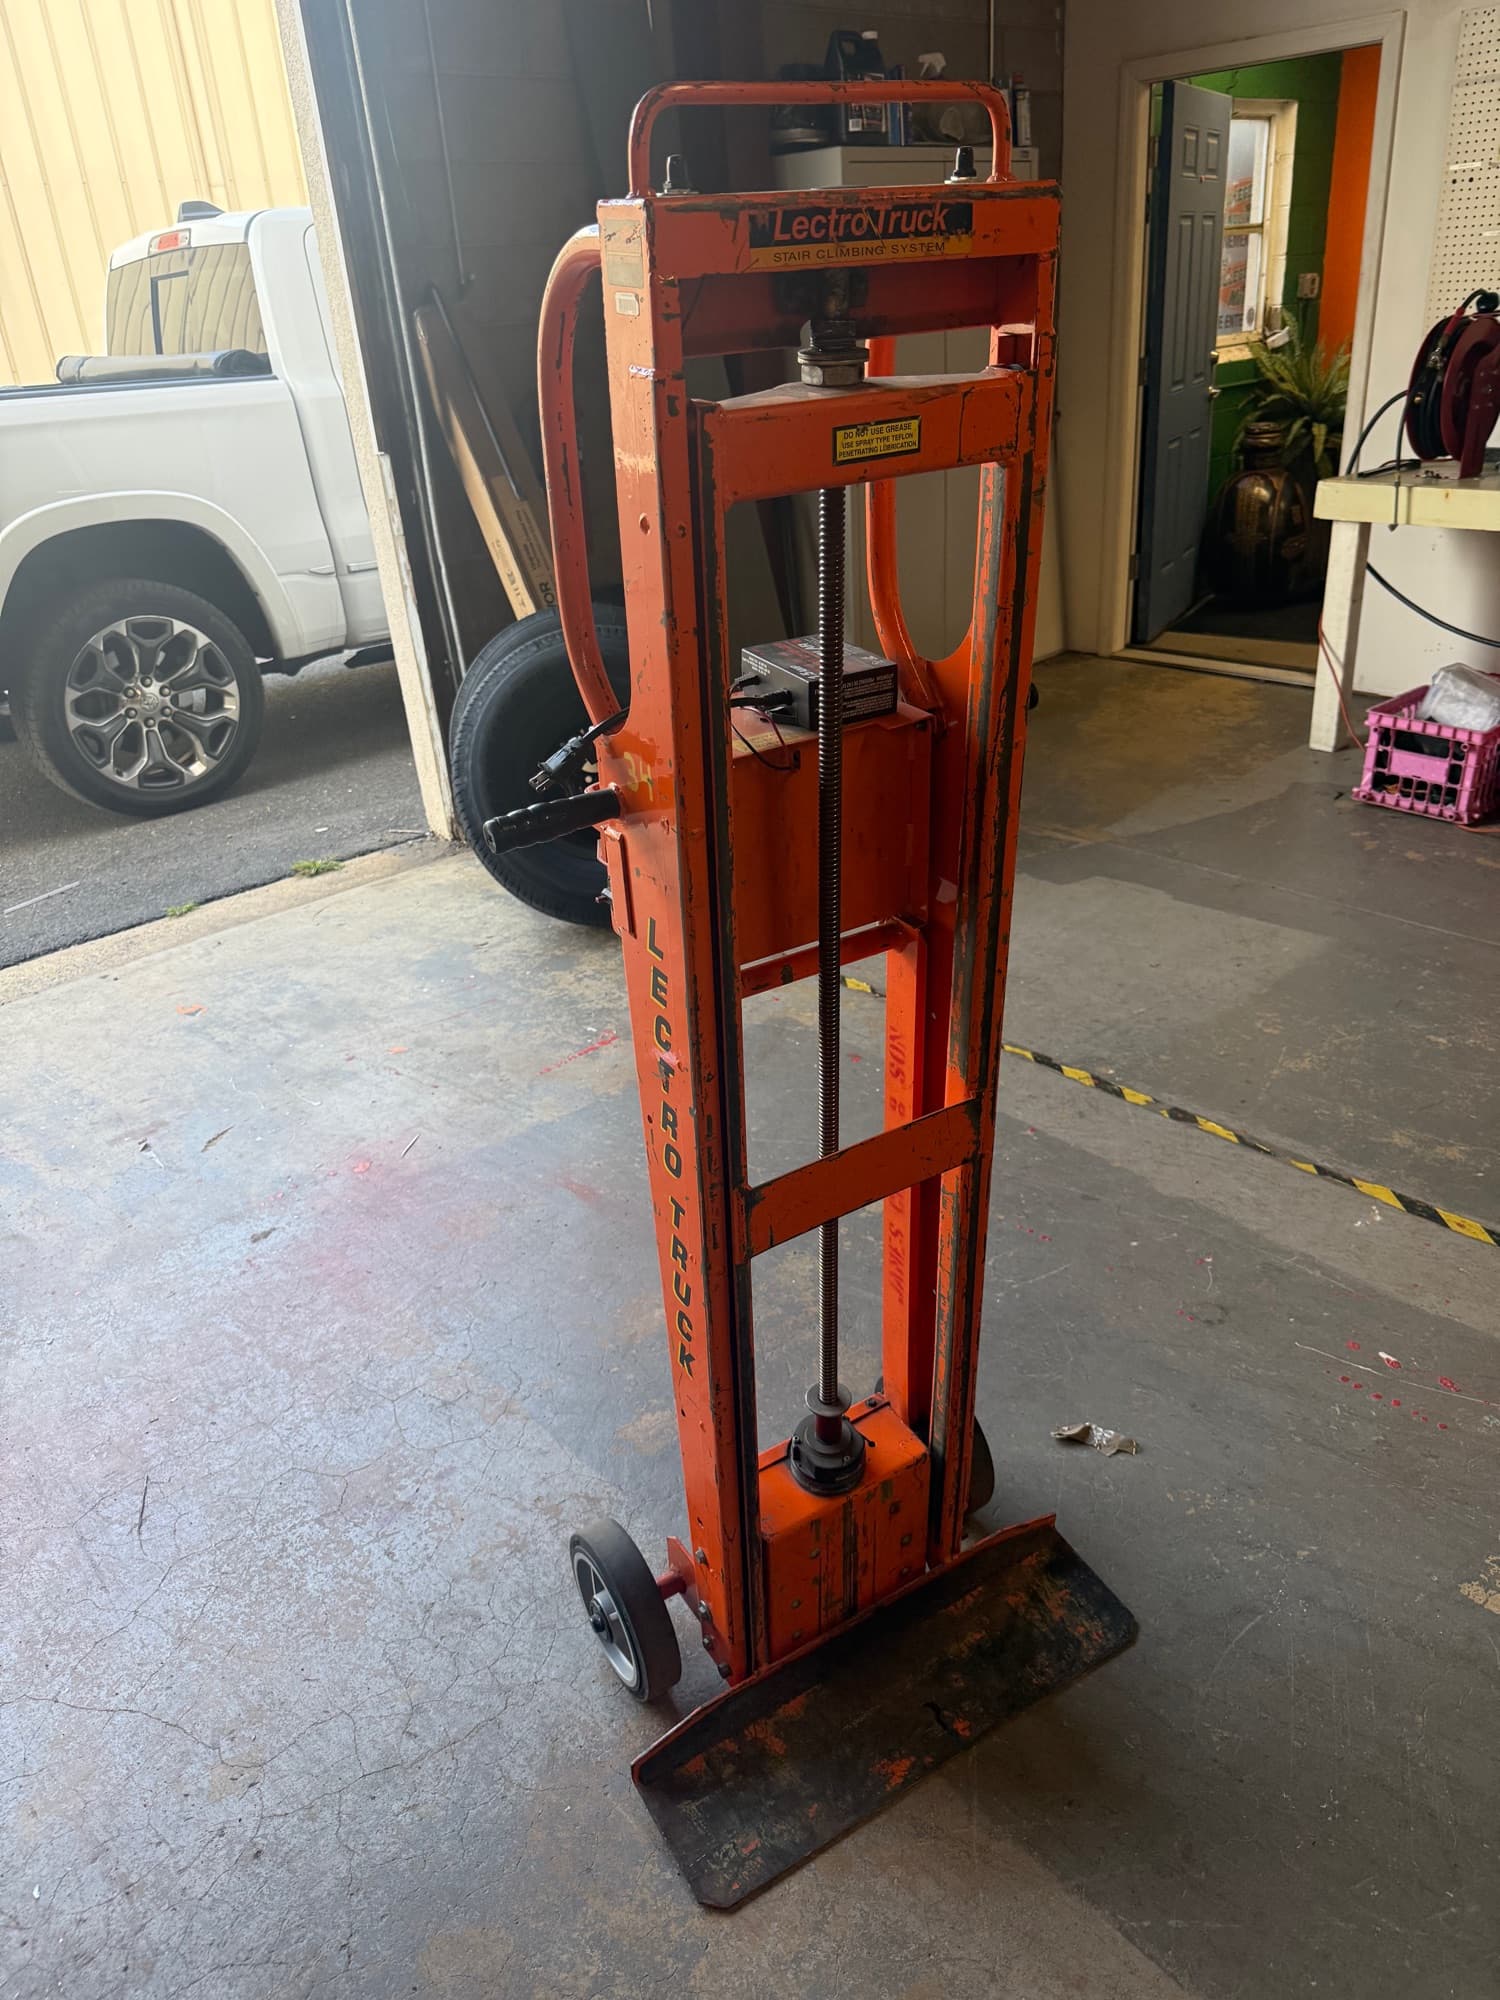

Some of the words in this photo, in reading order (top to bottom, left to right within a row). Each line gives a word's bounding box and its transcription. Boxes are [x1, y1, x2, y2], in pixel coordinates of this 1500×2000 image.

[773, 250, 811, 263] STAIR
[816, 245, 885, 260] CLIMBING
[891, 241, 946, 255] SYSTEM
[843, 431, 854, 440] DO
[855, 427, 869, 438] NOT
[870, 426, 885, 436] USE
[885, 422, 913, 433] GREASE
[839, 446, 879, 458] PENETRATING
[879, 440, 917, 453] LUBRICATION
[842, 441, 854, 449] USE
[856, 438, 876, 447] SPRAY
[876, 435, 891, 444] TYPE
[892, 432, 914, 441] TEFLON
[647, 916, 683, 1180] LECTRO
[668, 1195, 696, 1379] TRUCK
